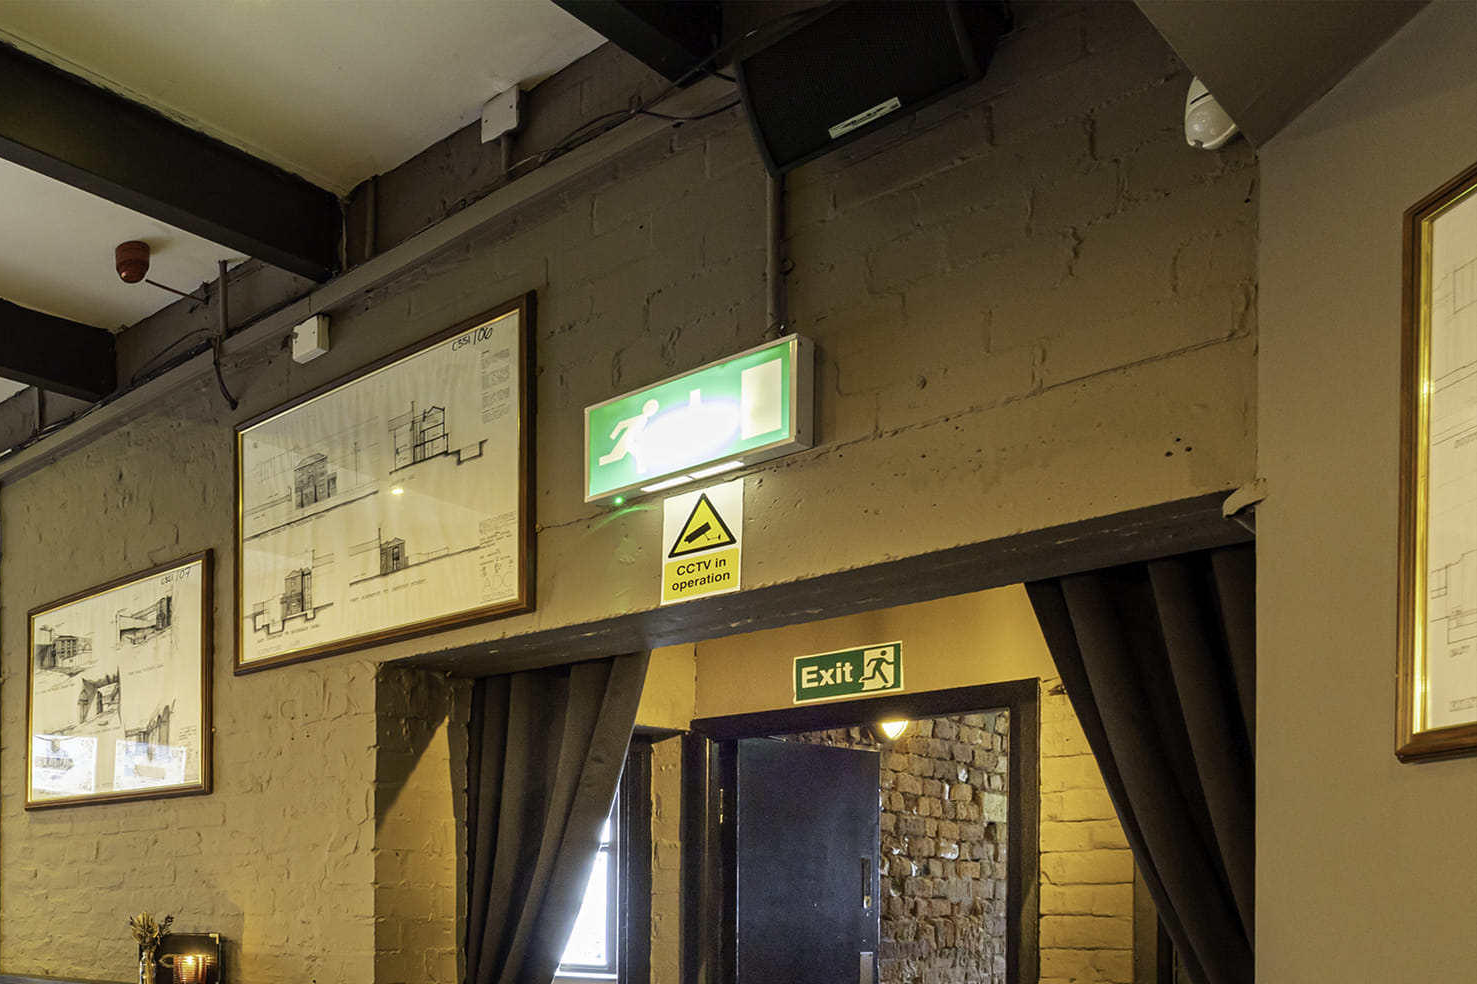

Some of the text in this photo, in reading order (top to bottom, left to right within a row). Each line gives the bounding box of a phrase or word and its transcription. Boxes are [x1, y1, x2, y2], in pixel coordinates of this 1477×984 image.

[676, 558, 726, 576] CCTV in
[671, 572, 730, 592] operation
[802, 662, 853, 689] Exit
